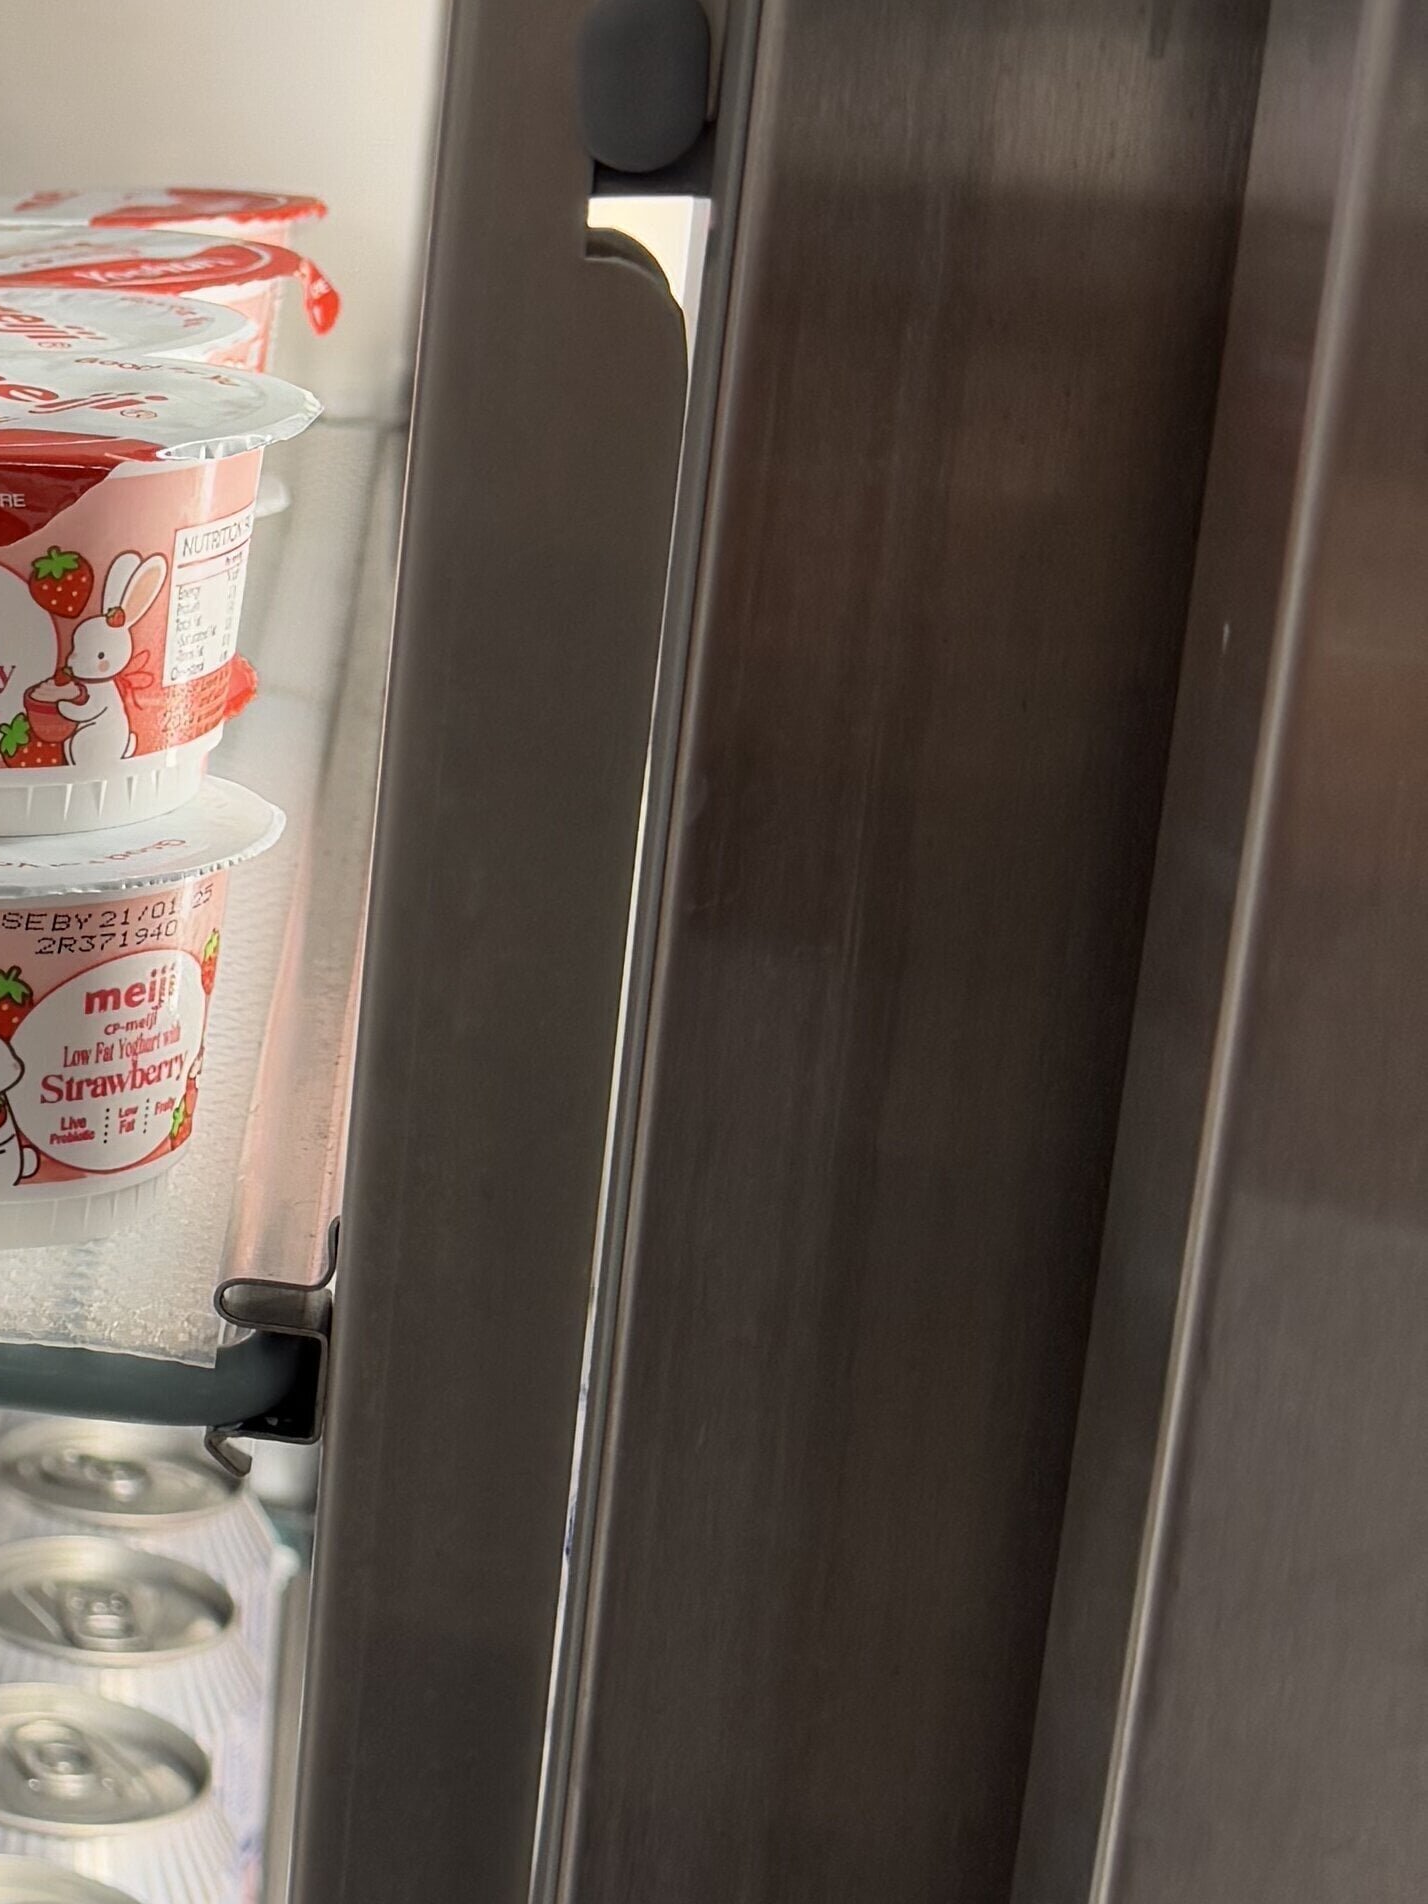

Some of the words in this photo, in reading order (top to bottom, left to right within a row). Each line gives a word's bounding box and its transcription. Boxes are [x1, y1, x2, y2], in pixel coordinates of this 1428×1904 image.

[35, 919, 178, 956] 2R371940
[84, 964, 178, 1016] meiji
[62, 1043, 92, 1070] Low
[94, 1040, 118, 1065] Fat
[116, 1029, 163, 1067] Yoghurt
[39, 1049, 188, 1106] Strawberry
[59, 1114, 88, 1132] Live
[118, 1104, 139, 1121] Low
[118, 1117, 136, 1135] Fat
